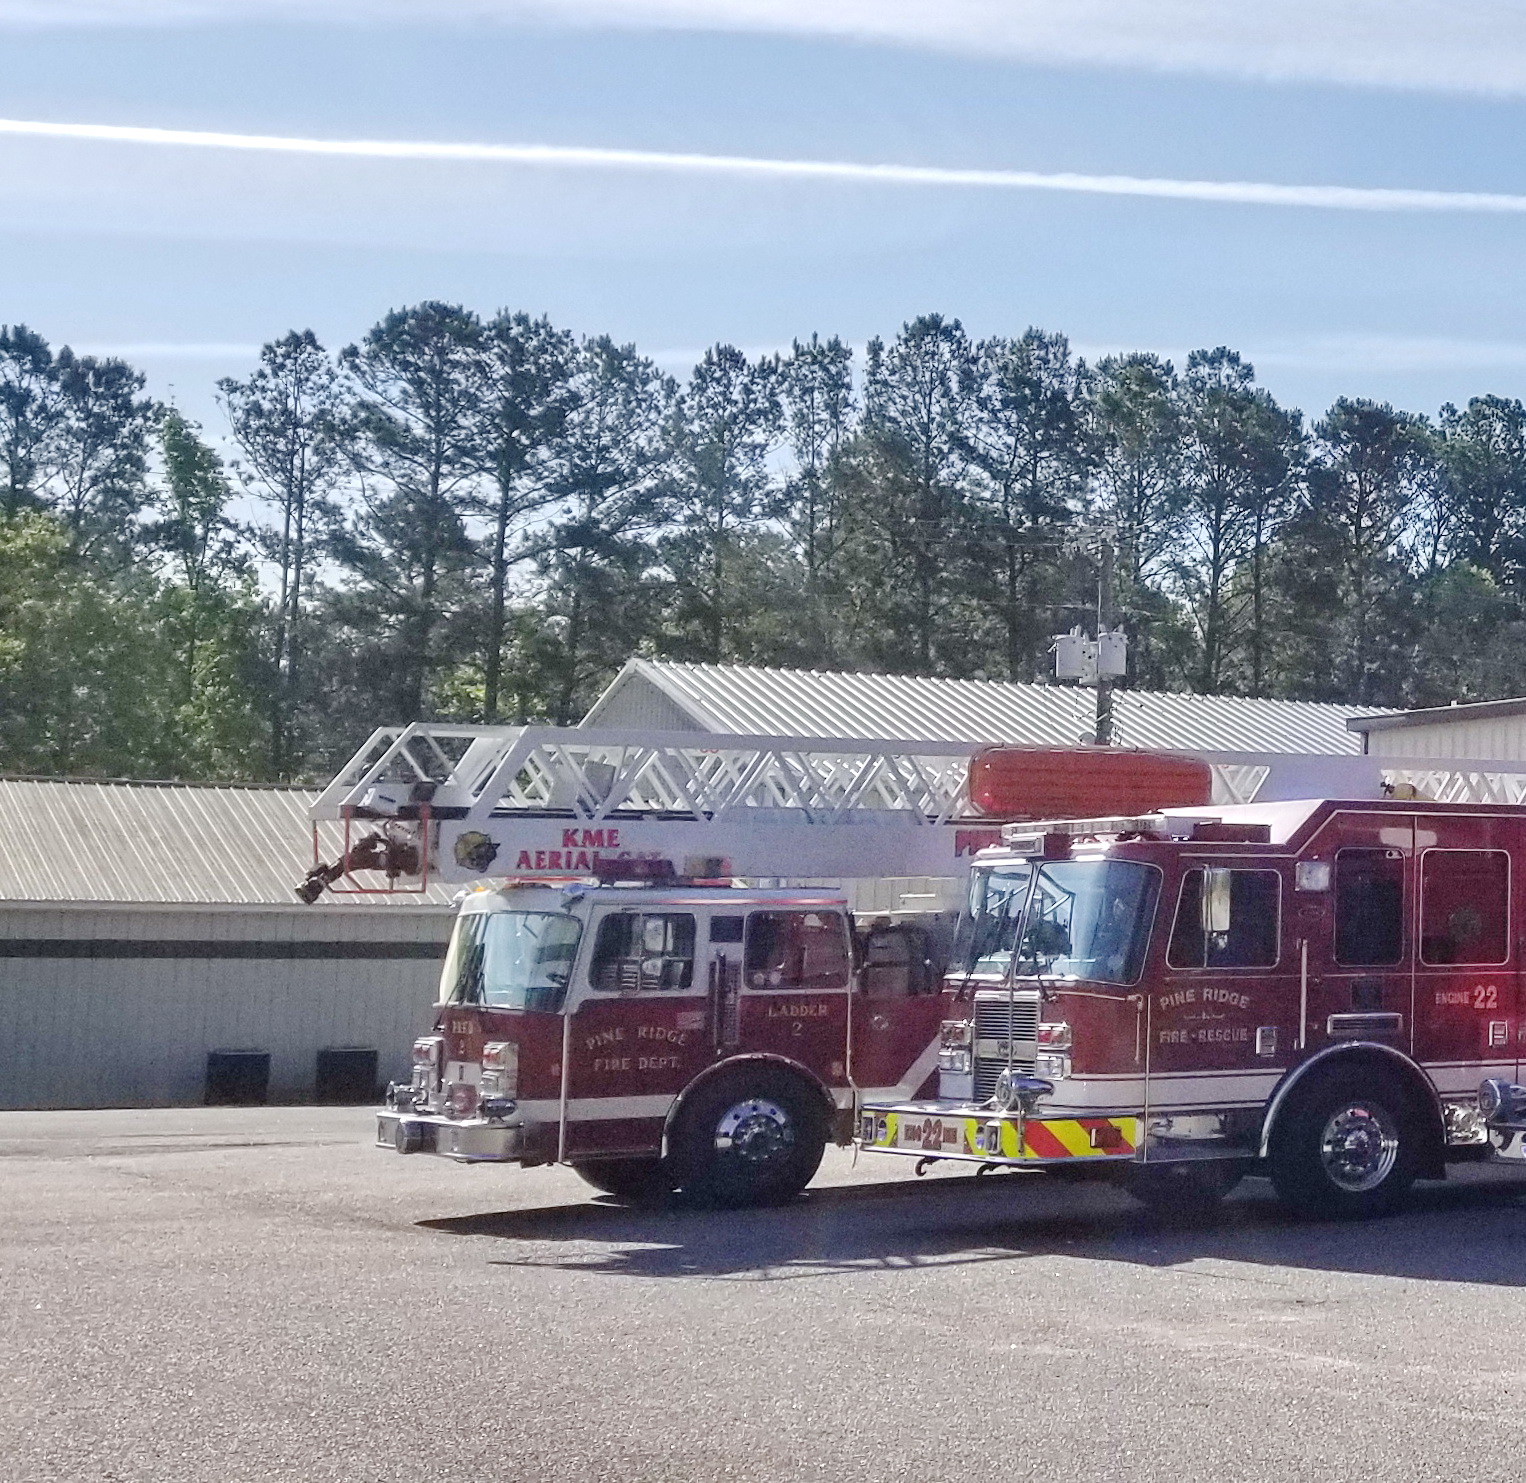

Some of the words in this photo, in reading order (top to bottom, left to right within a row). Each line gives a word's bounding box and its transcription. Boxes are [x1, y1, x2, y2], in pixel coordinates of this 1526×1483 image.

[562, 828, 620, 848] KME
[1159, 989, 1196, 1010] PINE
[1203, 987, 1250, 1009] RIDGE
[1435, 991, 1470, 1004] ENGINE
[1474, 985, 1497, 1009] 22
[768, 1004, 827, 1018] LADDER
[585, 1027, 625, 1050] PINE
[638, 1026, 688, 1046] RIDGE
[791, 1022, 802, 1036] 2
[594, 1058, 631, 1071] FIRE
[922, 1118, 943, 1151] 22
